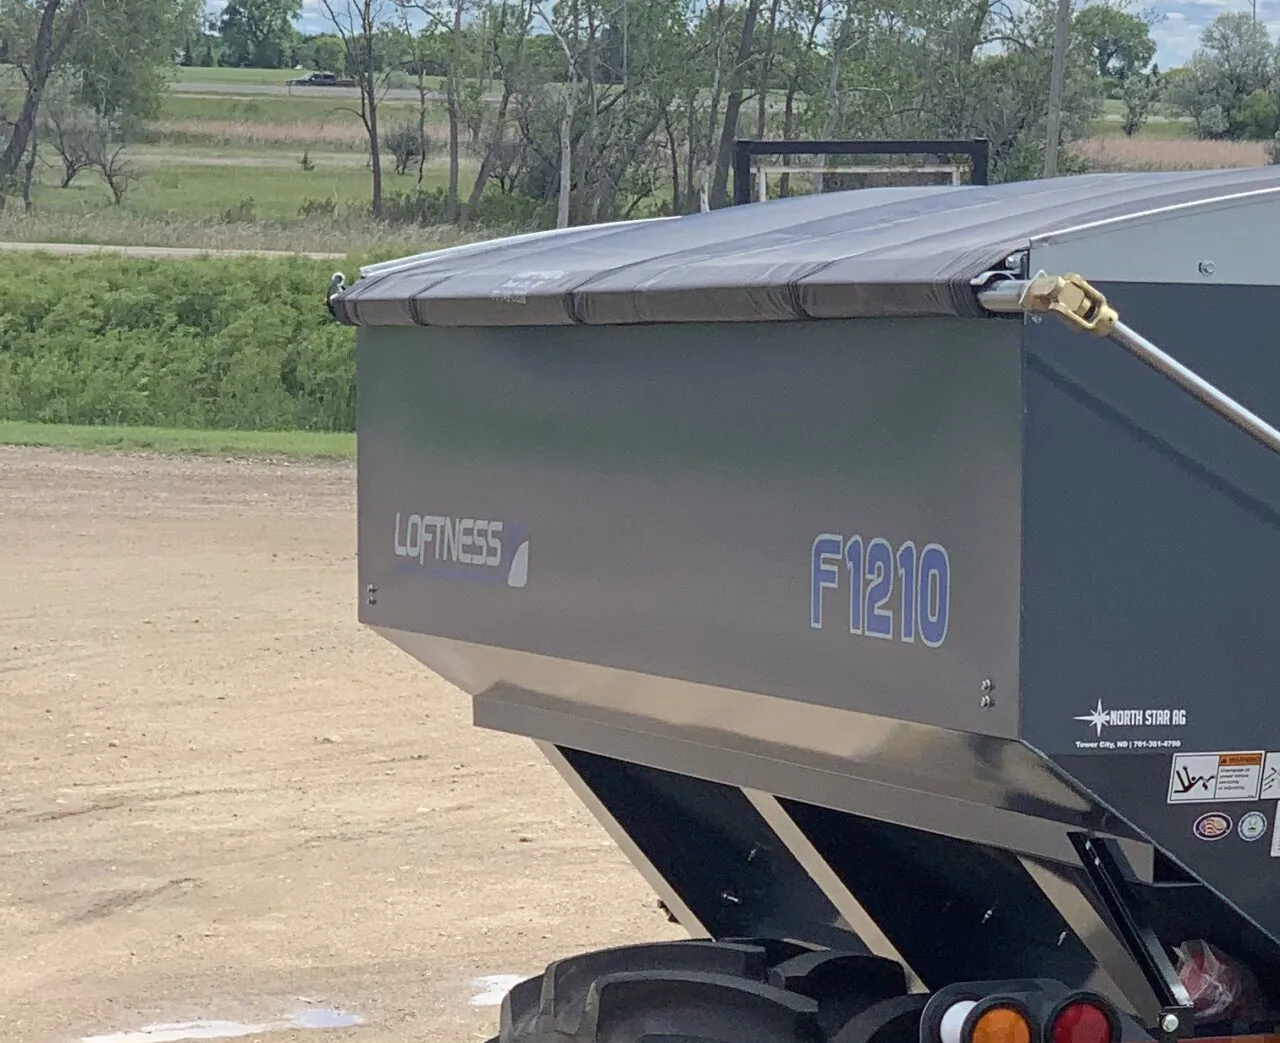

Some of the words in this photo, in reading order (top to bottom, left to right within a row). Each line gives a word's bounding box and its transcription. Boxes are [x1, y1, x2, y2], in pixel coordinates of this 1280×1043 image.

[394, 511, 504, 567] LOFTNESS
[811, 533, 950, 648] F1210
[1110, 709, 1143, 726] NORTH
[1145, 709, 1170, 726] STAR
[1172, 709, 1187, 726] AG
